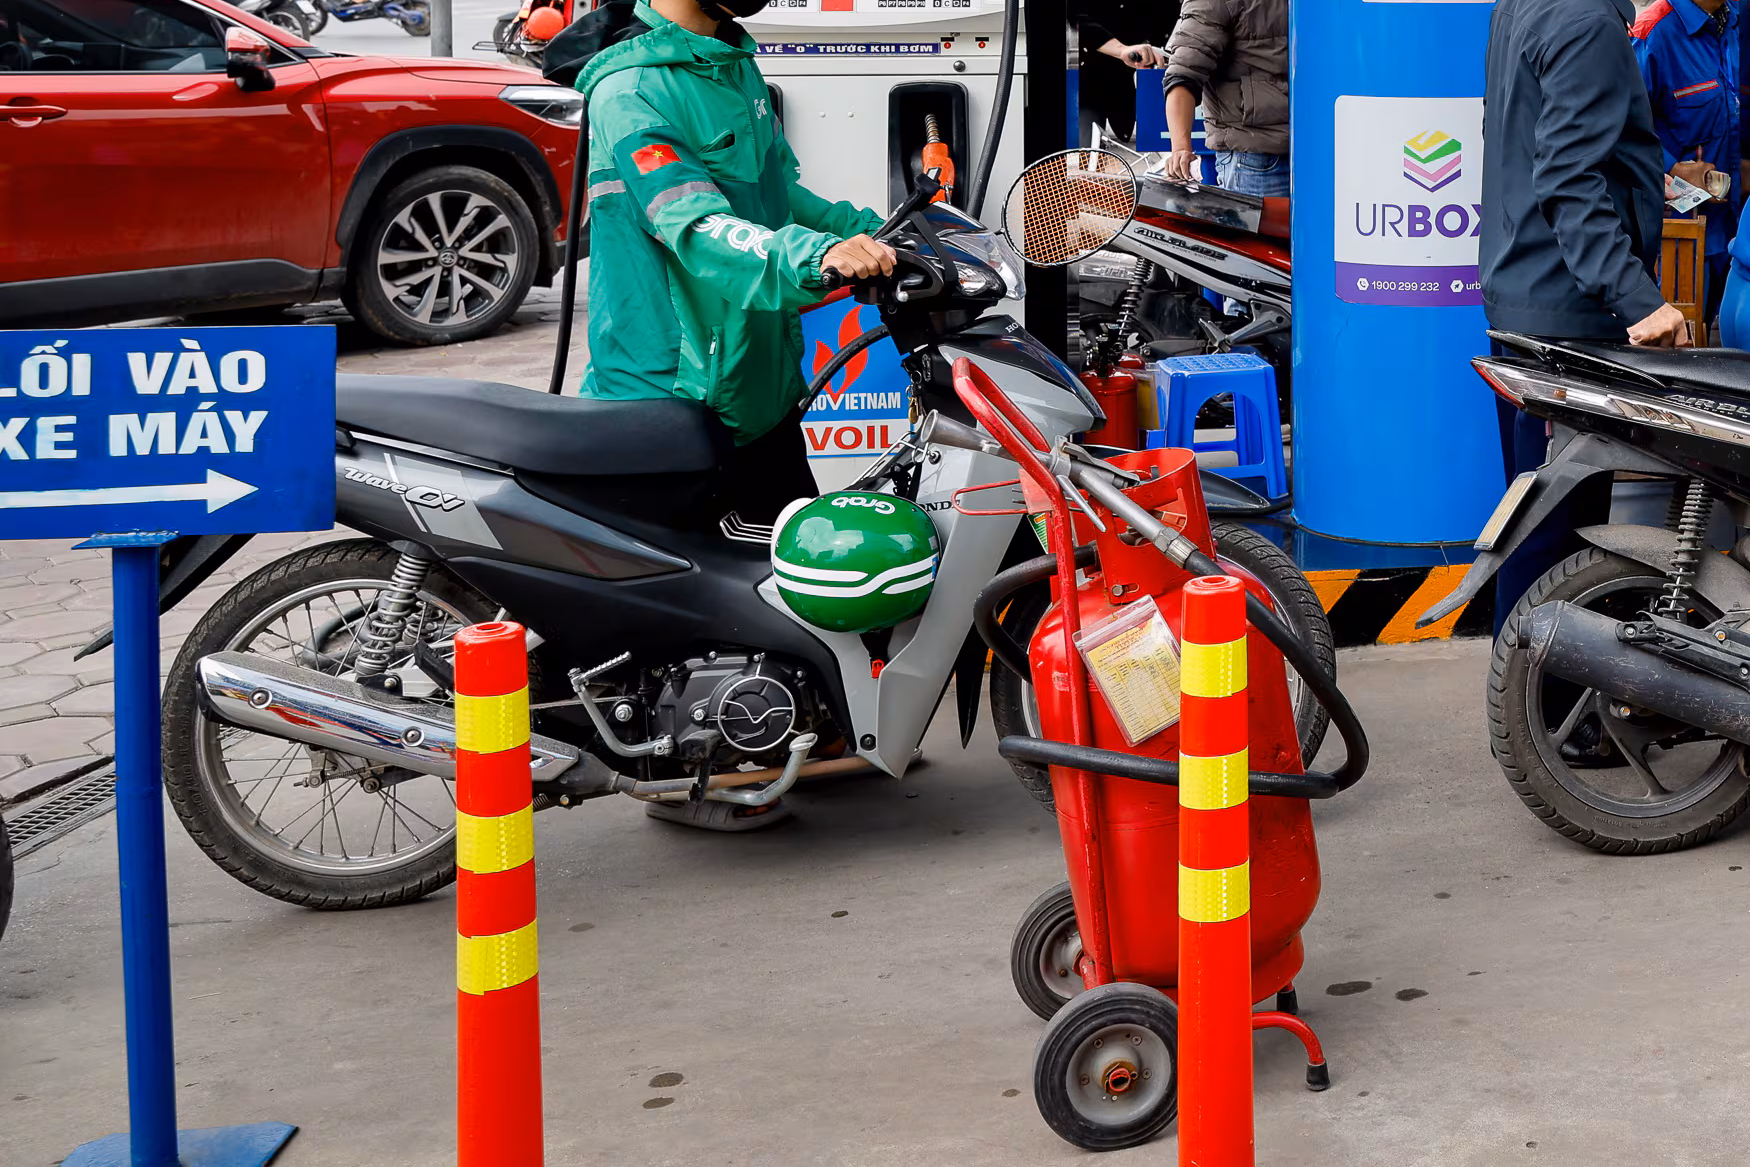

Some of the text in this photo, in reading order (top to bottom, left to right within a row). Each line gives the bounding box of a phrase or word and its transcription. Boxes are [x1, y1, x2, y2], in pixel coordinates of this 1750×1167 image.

[765, 43, 783, 53] VỀ
[818, 42, 866, 53] TRƯỚC
[900, 44, 933, 52] BƠM
[1372, 281, 1440, 291] 1900 299 232
[0, 338, 267, 397] ỐI VÀO
[0, 402, 269, 460] XE MÁY
[344, 466, 407, 495] Wave
[831, 495, 896, 515] Grab
